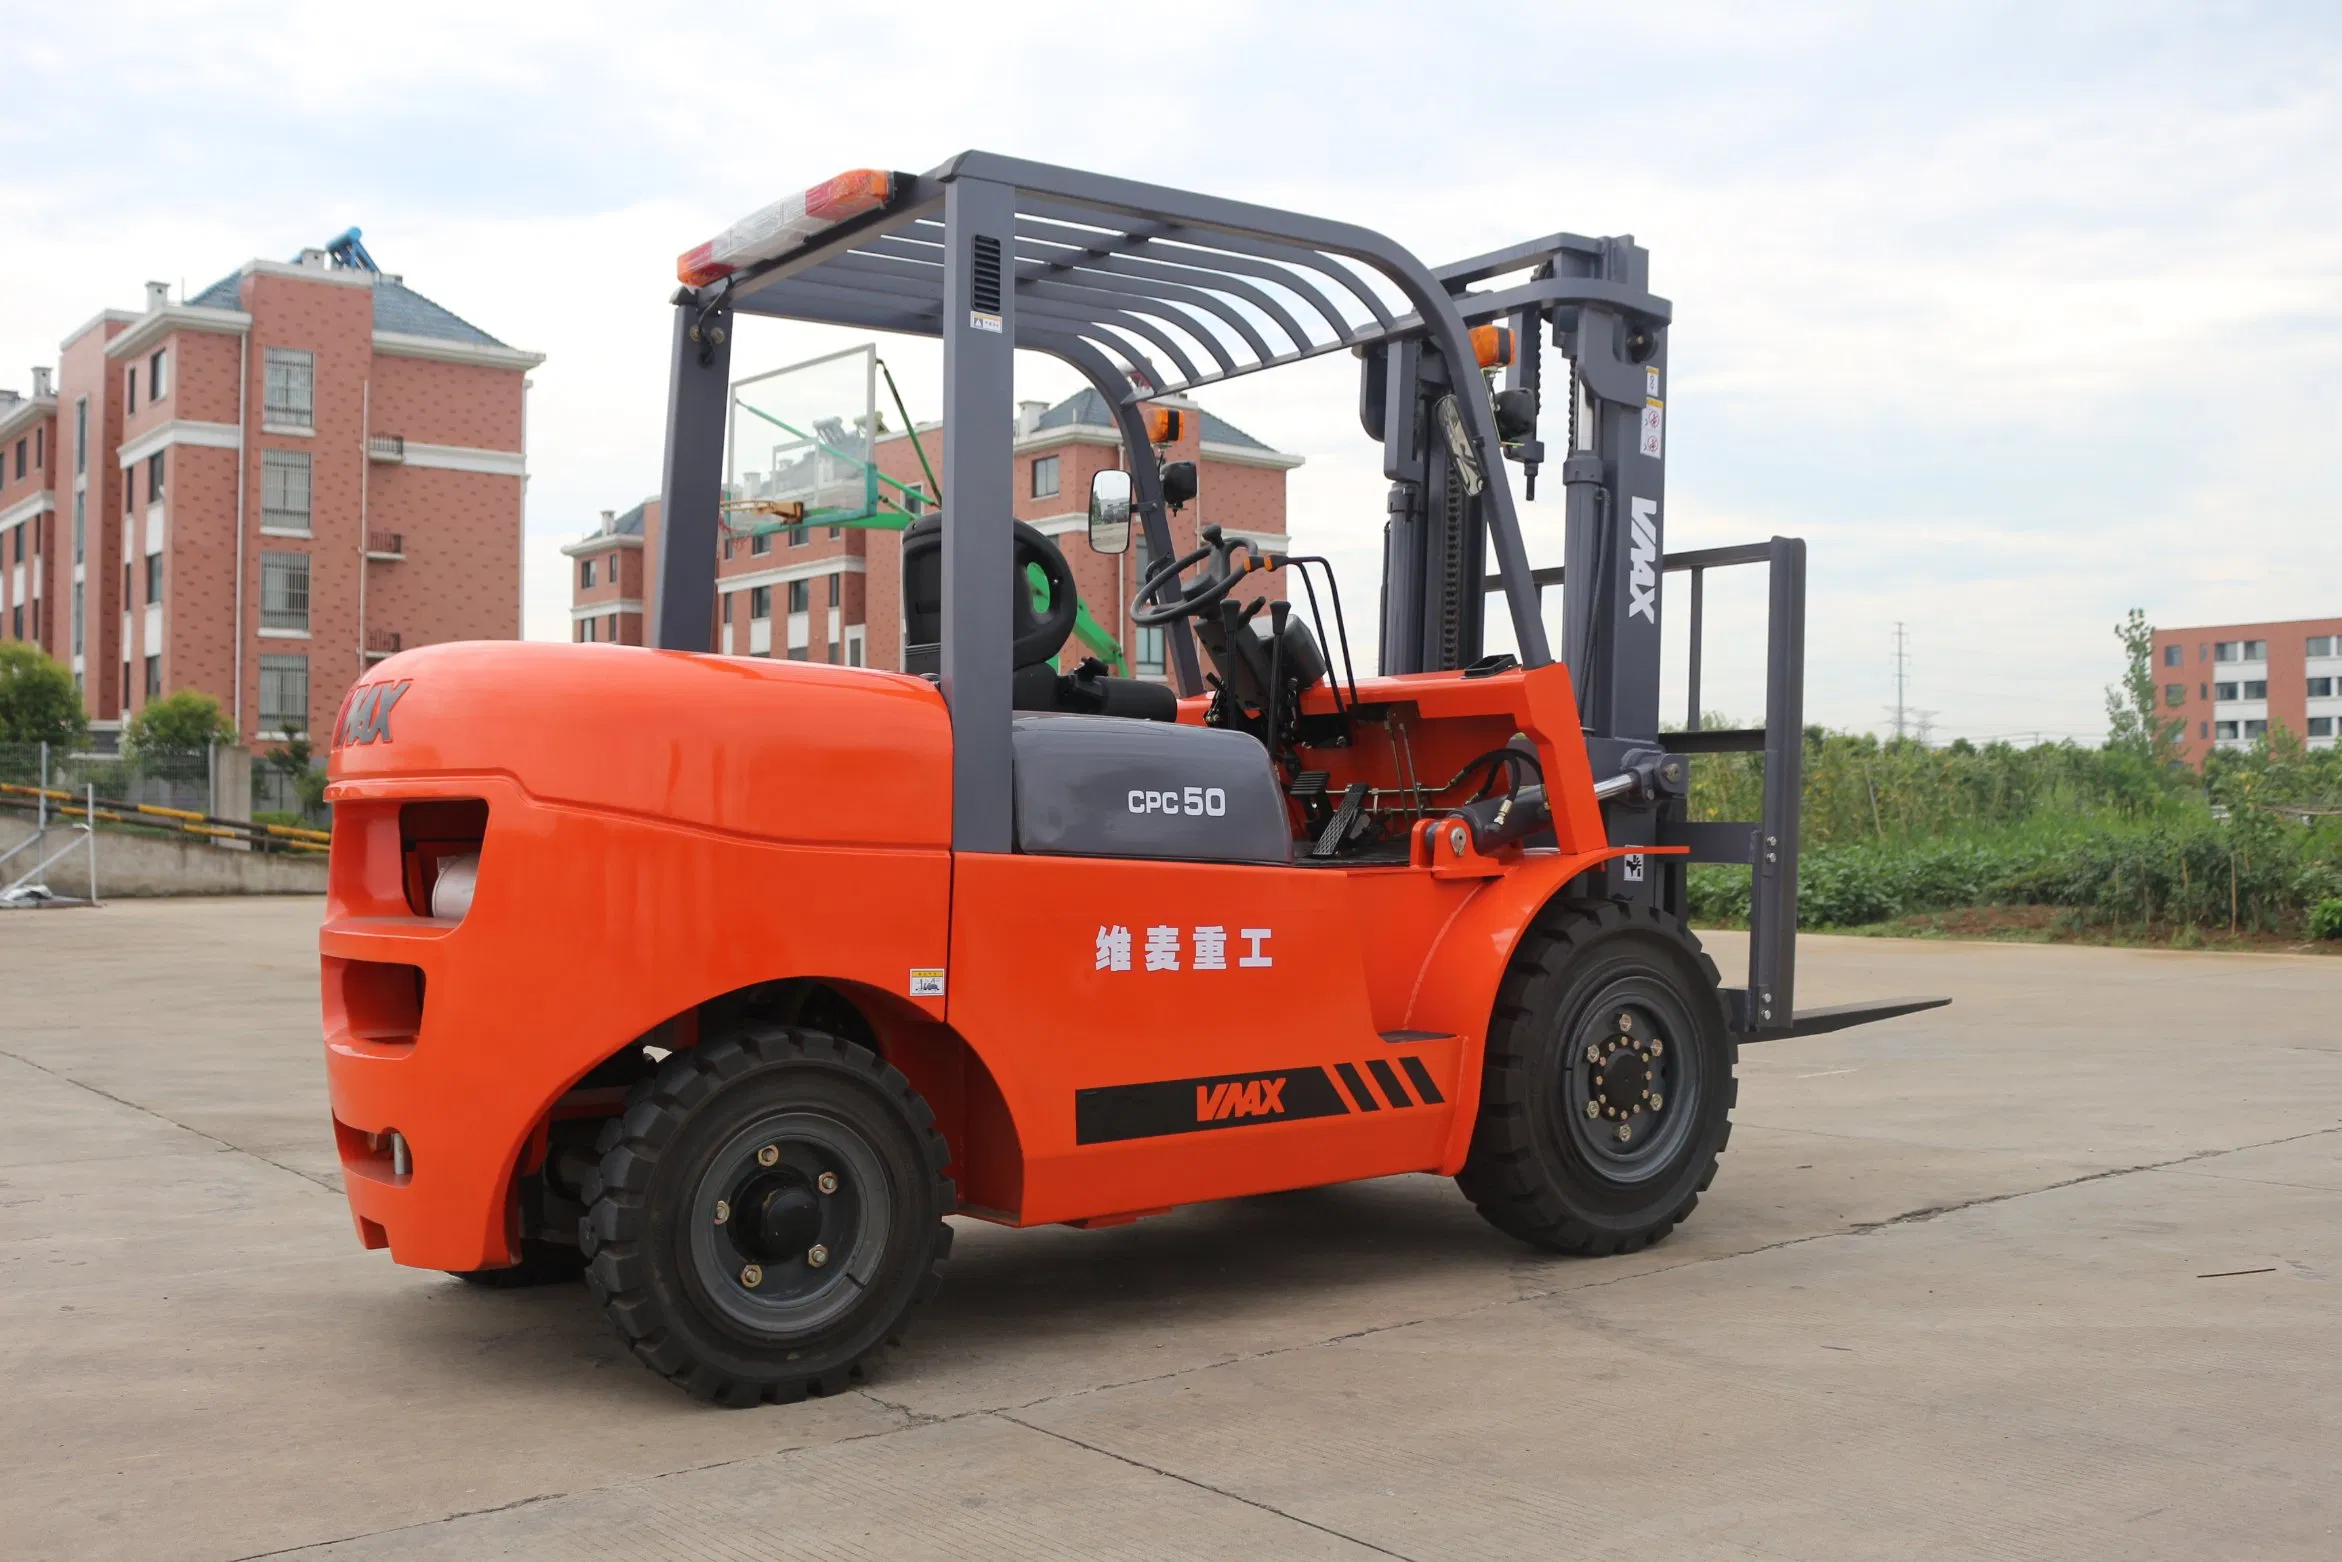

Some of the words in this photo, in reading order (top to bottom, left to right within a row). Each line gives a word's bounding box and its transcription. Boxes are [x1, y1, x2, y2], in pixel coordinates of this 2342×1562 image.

[1630, 497, 1657, 624] VMAX
[1096, 925, 1273, 972] 维麦重工
[1197, 1078, 1286, 1122] VMAX
